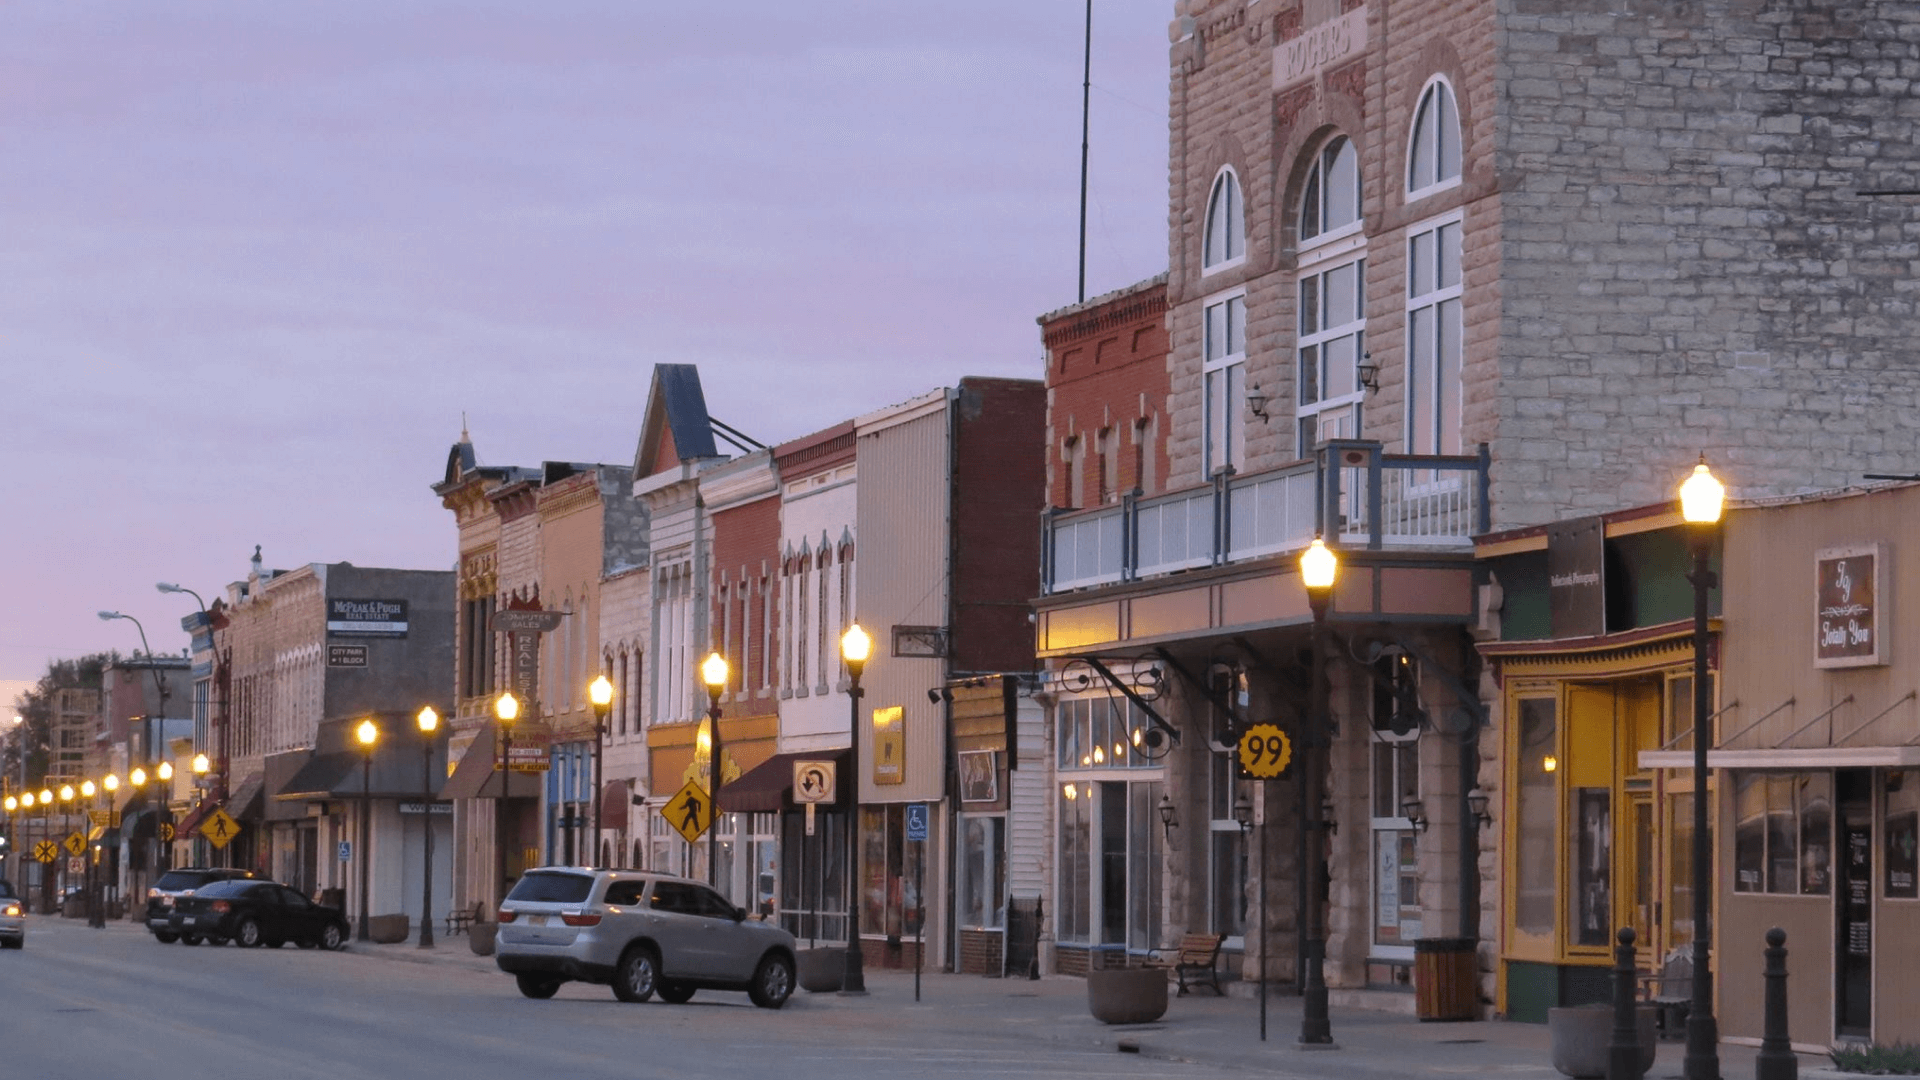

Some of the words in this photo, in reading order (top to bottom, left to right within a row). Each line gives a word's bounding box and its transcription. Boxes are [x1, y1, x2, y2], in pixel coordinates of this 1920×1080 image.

[1286, 18, 1351, 81] ROGERS
[512, 621, 540, 629] SALES
[1821, 621, 1847, 649] Totally
[1848, 618, 1869, 645] You
[518, 635, 532, 667] REAL
[1246, 734, 1284, 766] 99
